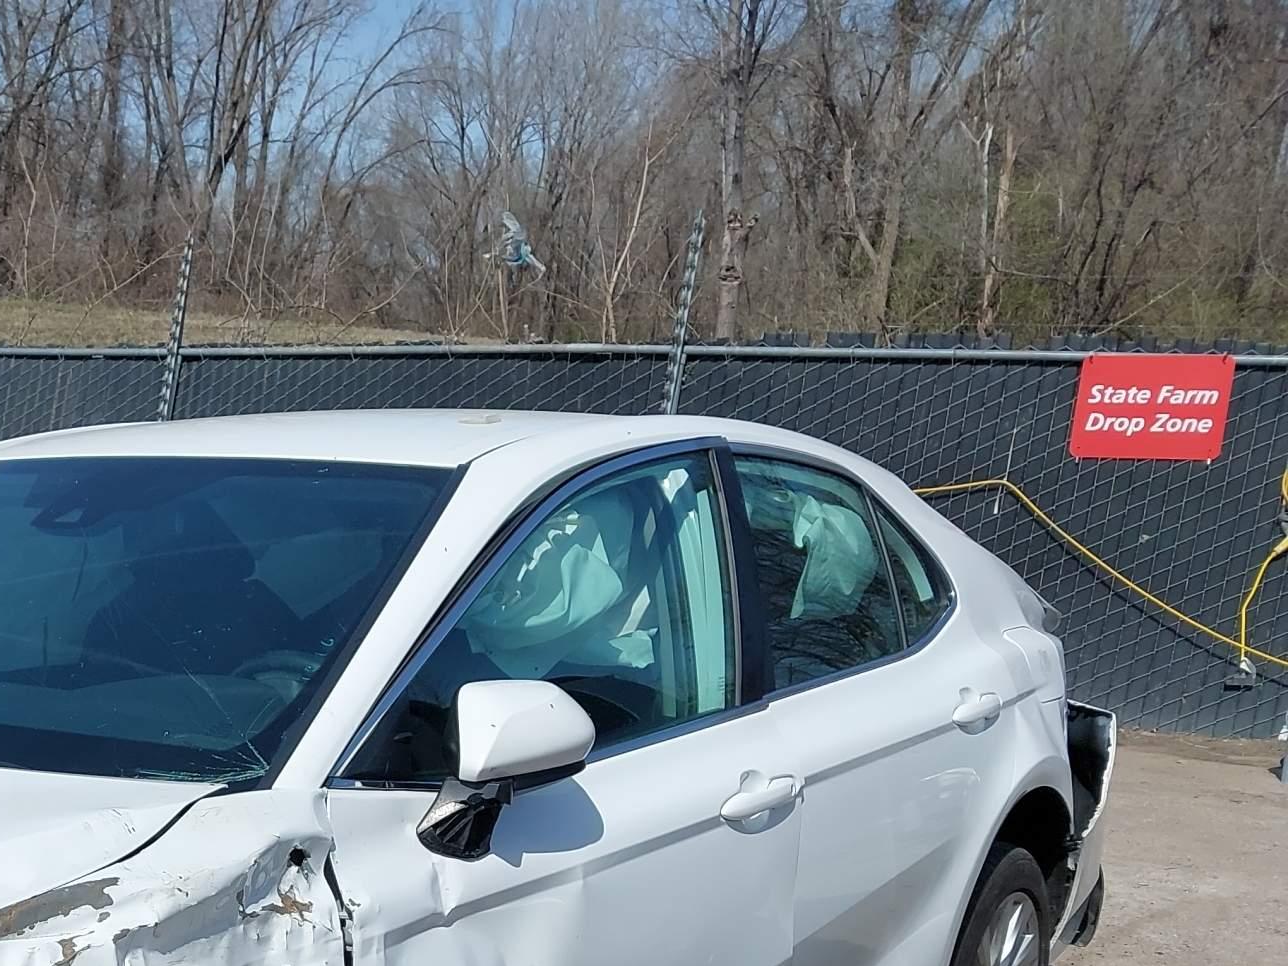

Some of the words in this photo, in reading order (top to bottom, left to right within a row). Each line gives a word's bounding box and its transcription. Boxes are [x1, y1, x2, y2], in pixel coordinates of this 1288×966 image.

[1087, 384, 1152, 405] State
[1157, 385, 1219, 405] Farm
[1085, 412, 1145, 437] Drop
[1150, 413, 1213, 433] Zone
